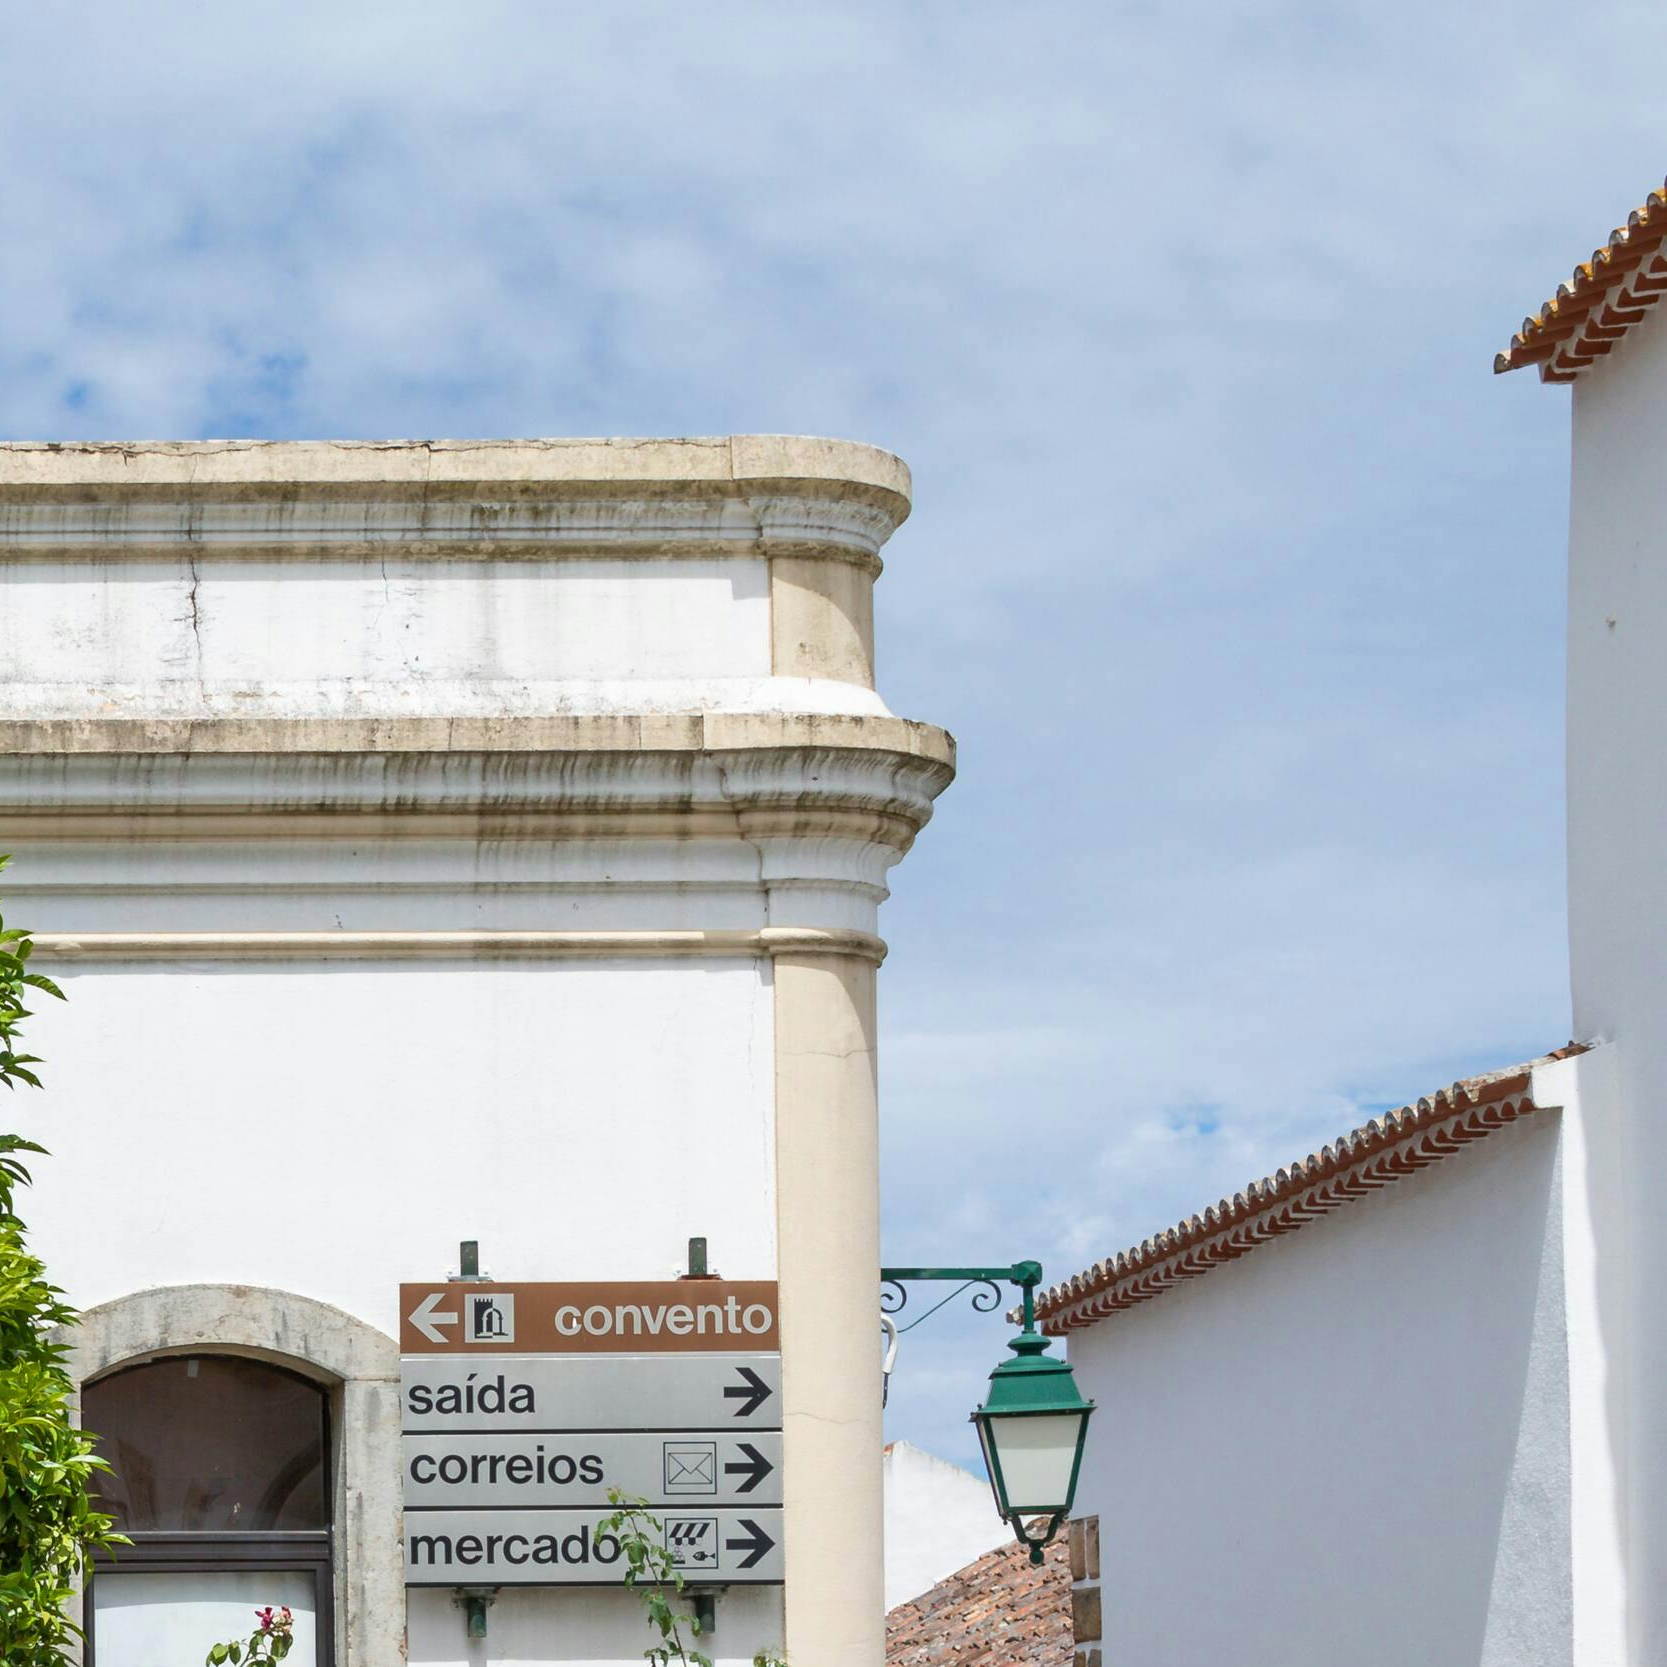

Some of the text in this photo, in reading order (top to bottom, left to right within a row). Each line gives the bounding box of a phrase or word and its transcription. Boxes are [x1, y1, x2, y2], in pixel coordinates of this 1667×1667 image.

[553, 1295, 773, 1338] convento
[408, 1373, 536, 1415] saída
[409, 1444, 605, 1486] correios
[409, 1525, 623, 1566] mercado
